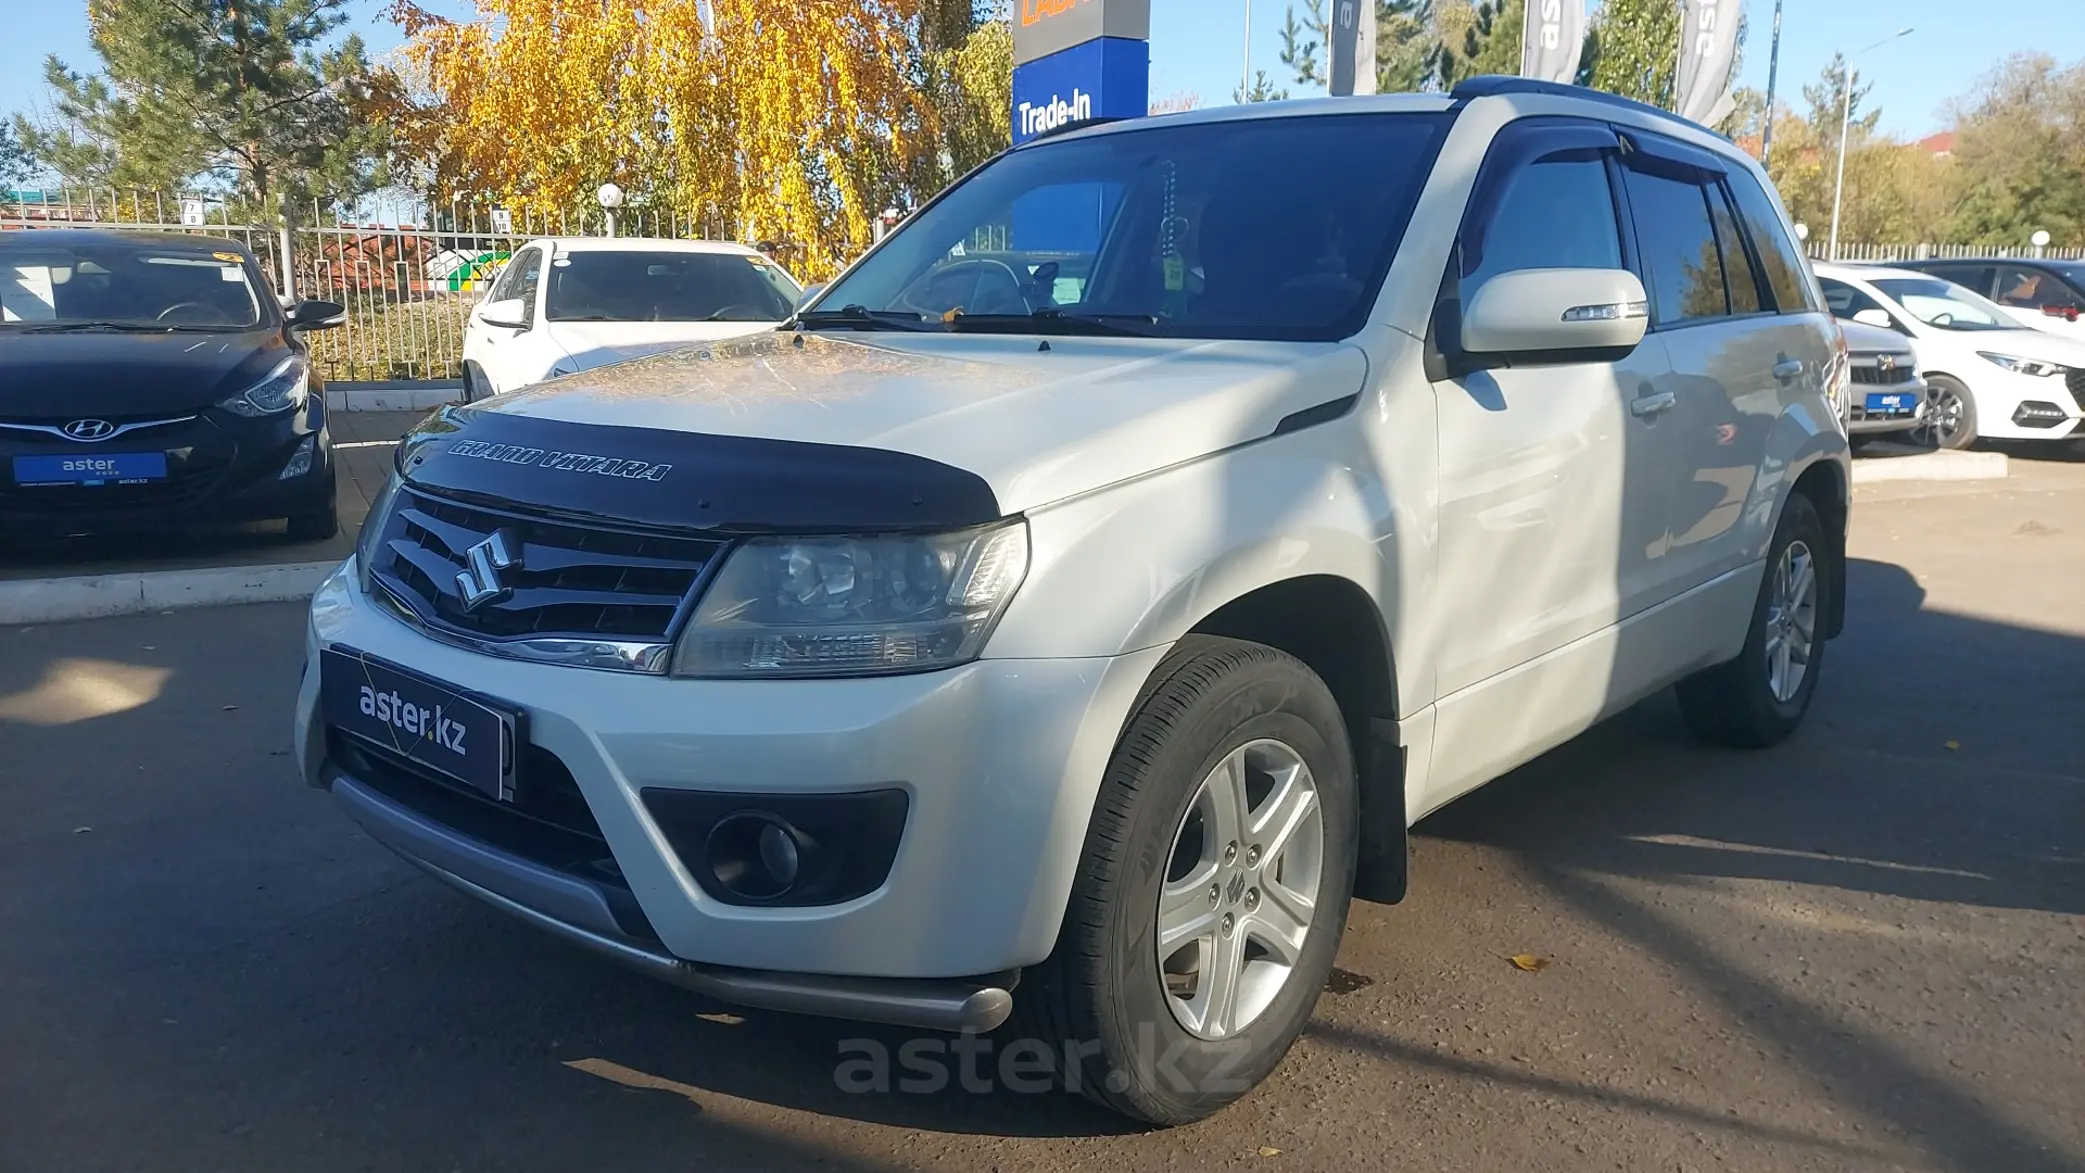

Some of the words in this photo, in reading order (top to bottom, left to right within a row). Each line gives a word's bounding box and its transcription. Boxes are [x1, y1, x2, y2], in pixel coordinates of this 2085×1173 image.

[1019, 88, 1091, 135] Trade-In
[62, 458, 116, 471] aster
[447, 439, 544, 466] GRAND
[539, 451, 673, 482] VITARA
[359, 685, 467, 756] aster.kz
